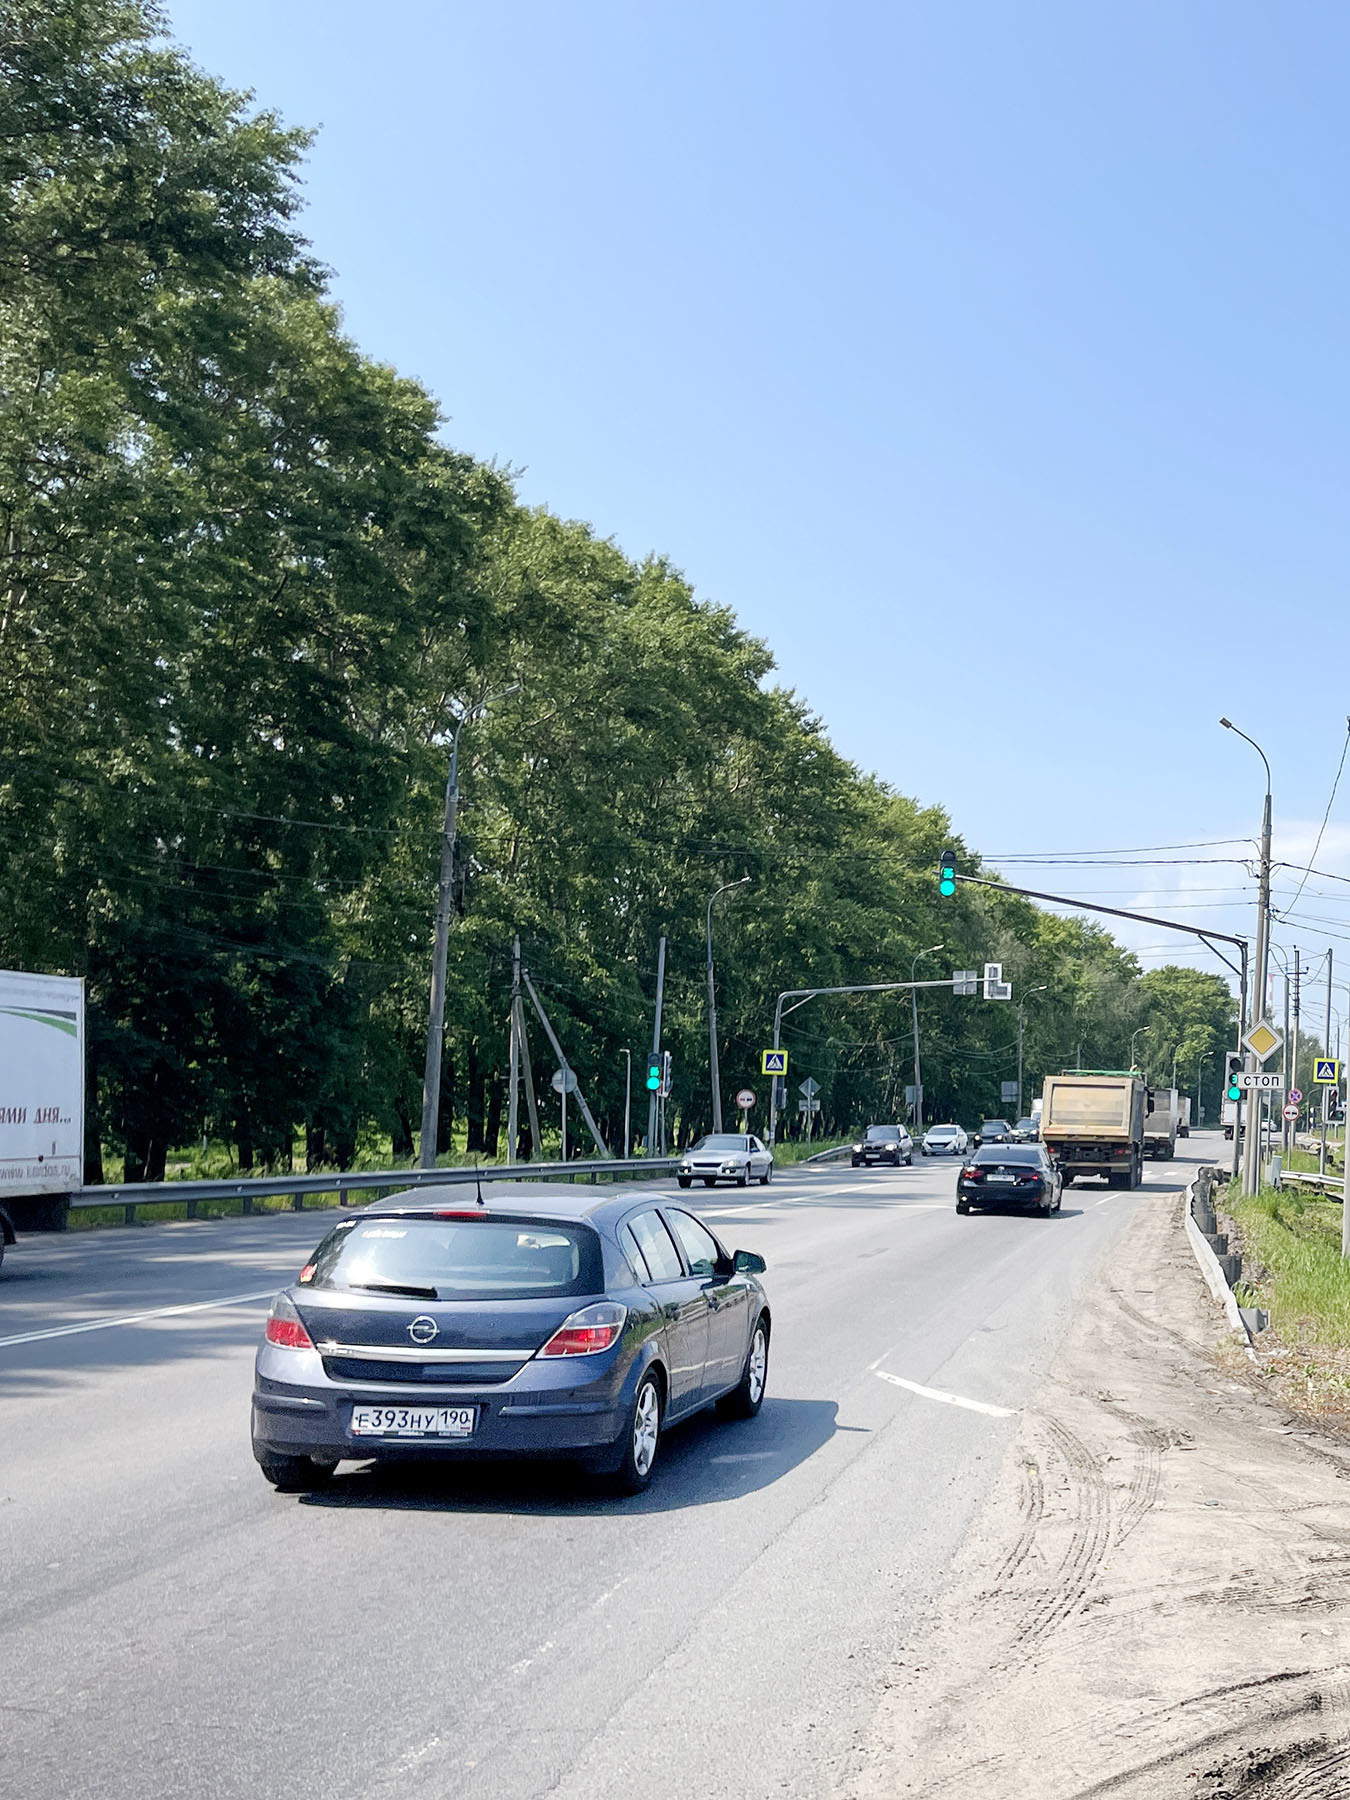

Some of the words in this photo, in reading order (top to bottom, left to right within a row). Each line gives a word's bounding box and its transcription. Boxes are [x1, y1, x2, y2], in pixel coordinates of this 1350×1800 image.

[1243, 1075, 1280, 1086] СТОП
[358, 1410, 435, 1429] Е393НУ
[440, 1410, 470, 1425] 190
